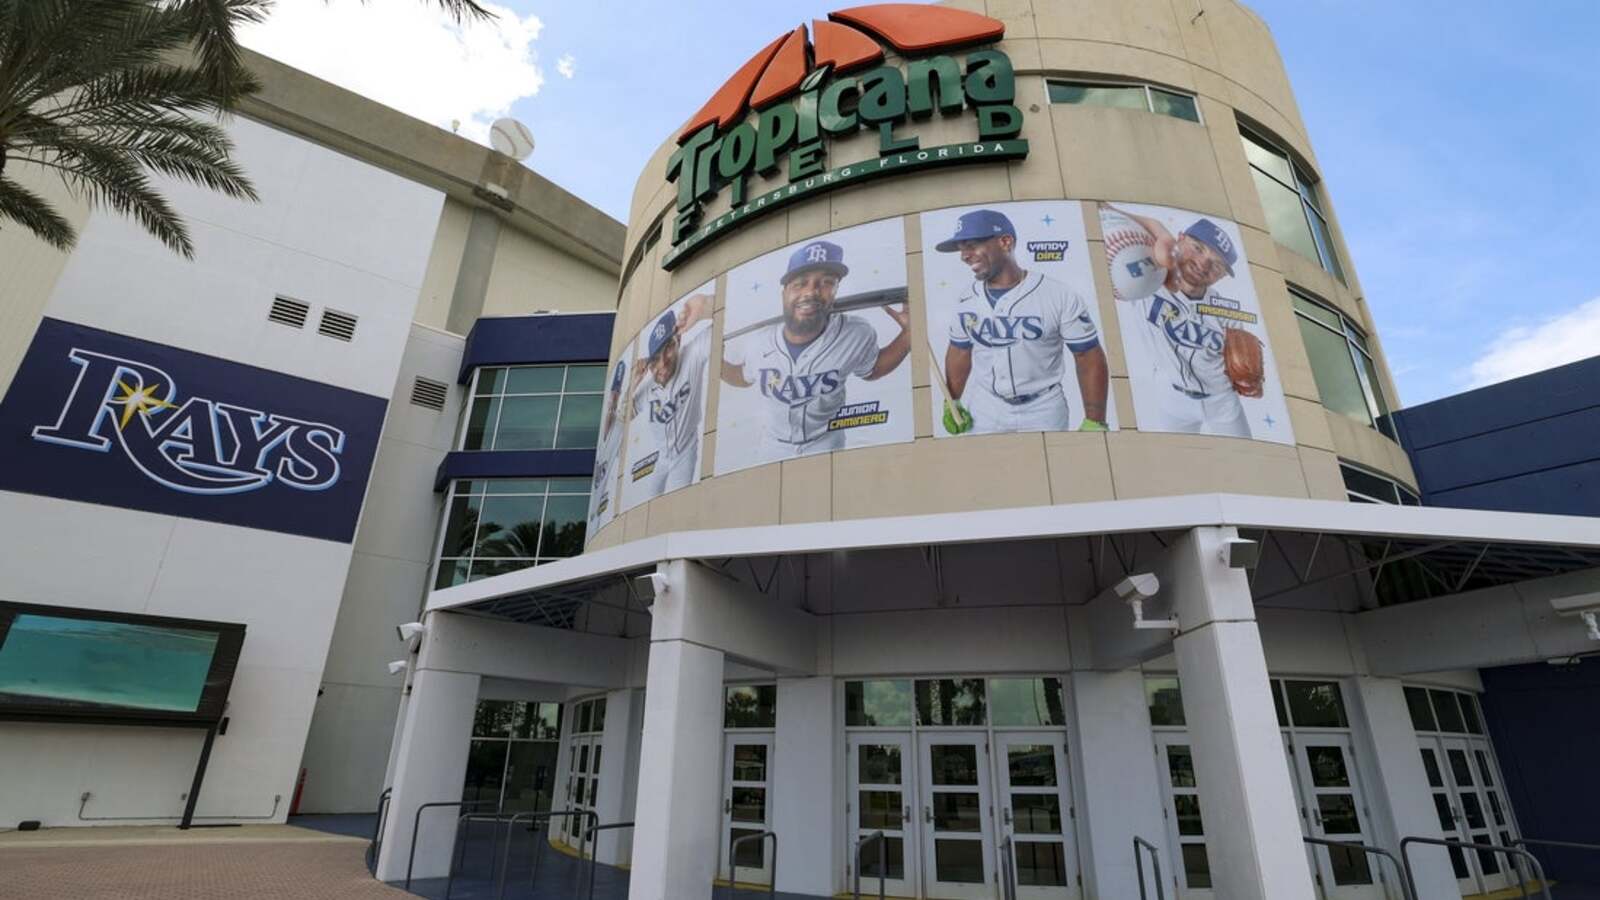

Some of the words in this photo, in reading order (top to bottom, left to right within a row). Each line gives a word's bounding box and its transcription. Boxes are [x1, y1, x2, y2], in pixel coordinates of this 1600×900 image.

[665, 50, 1016, 213] Tropicana
[879, 143, 1004, 168] FLORIDA
[672, 104, 1024, 248] FIELD
[1029, 242, 1067, 251] YANDY
[958, 311, 1043, 347] RAYS
[1147, 293, 1226, 352] RAYS
[759, 368, 840, 406] RAYS
[32, 348, 346, 495] RAYS
[838, 402, 879, 418] JUNIOR
